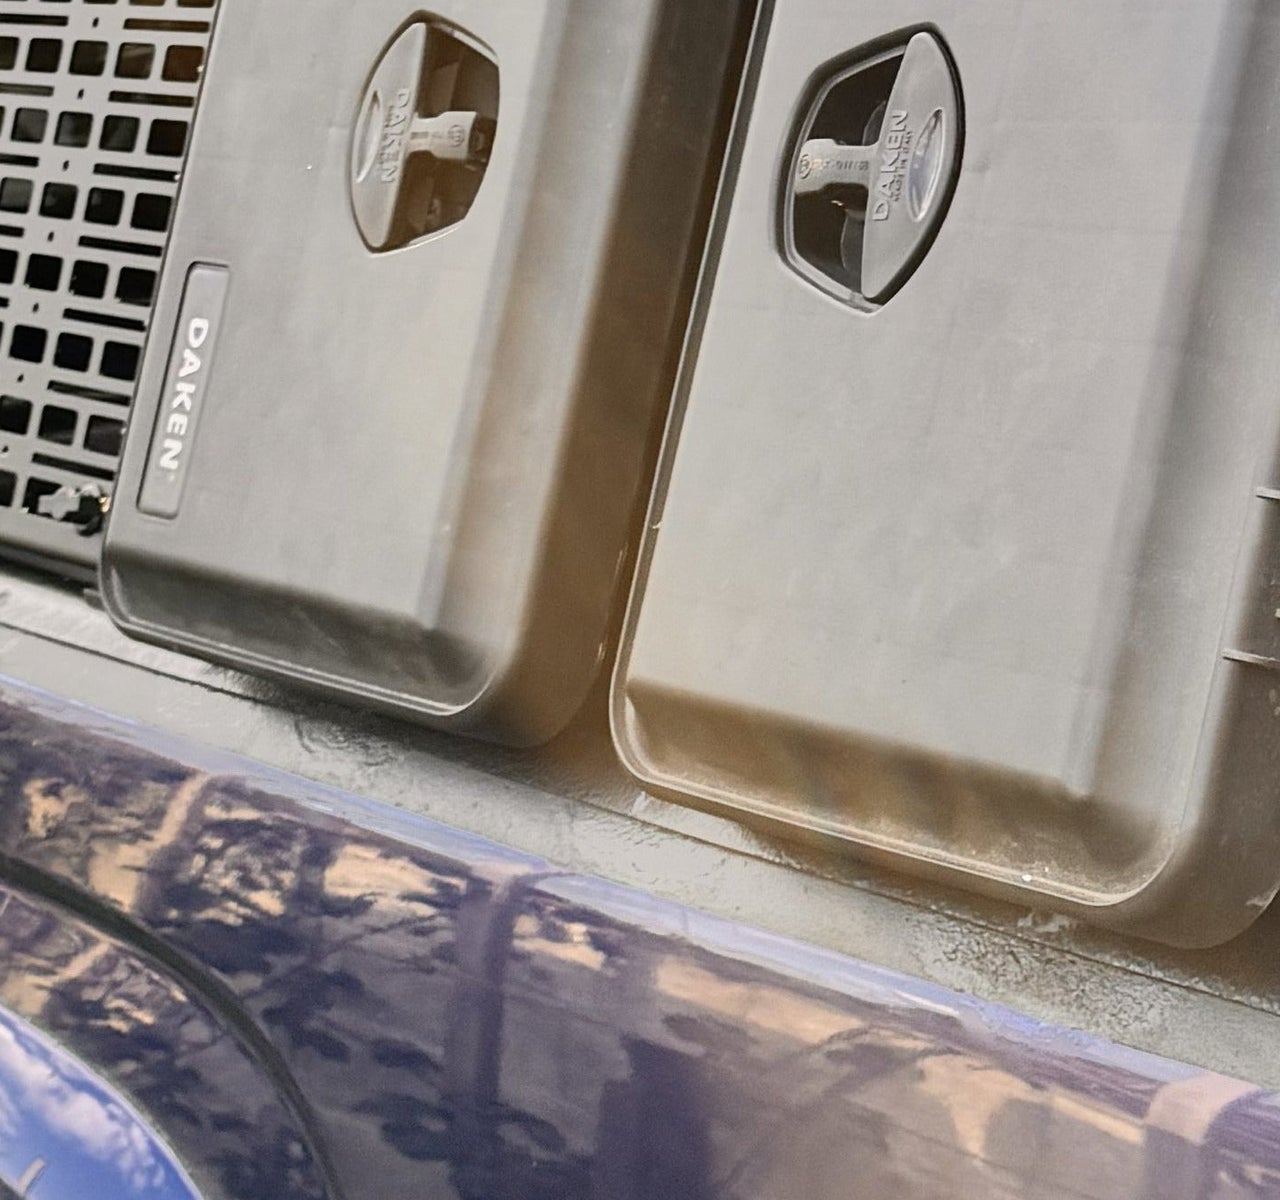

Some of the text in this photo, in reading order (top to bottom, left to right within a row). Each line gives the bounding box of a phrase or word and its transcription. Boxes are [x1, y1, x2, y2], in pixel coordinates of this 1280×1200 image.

[380, 88, 411, 184] DAKEN
[872, 110, 908, 222] DAKEN
[159, 317, 209, 470] DAKEN
